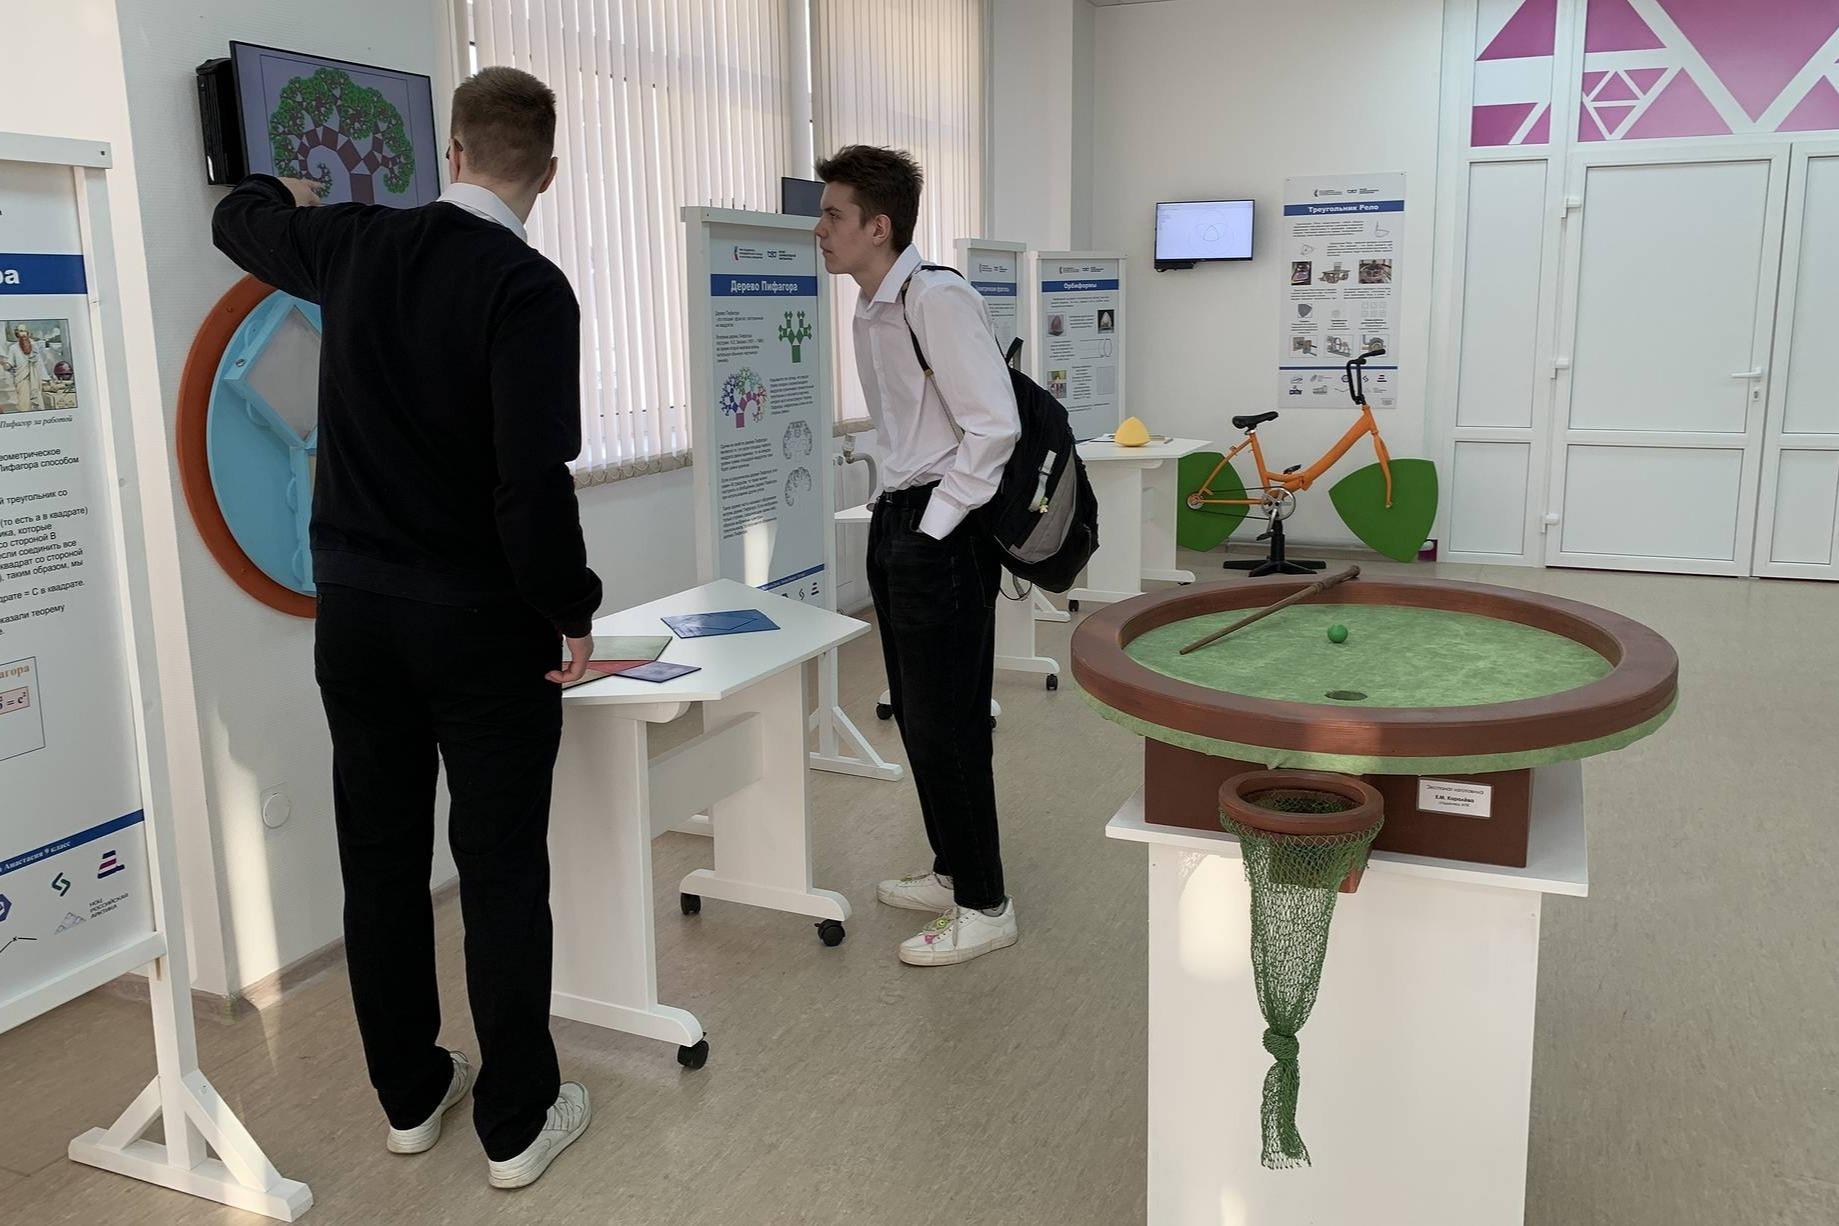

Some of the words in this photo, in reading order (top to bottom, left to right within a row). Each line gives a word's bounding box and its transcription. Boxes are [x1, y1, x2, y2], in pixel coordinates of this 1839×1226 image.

[730, 280, 760, 293] Дерево
[761, 280, 798, 294] Пифагора
[1063, 282, 1097, 290] Орбиформы
[41, 456, 80, 468] способом
[7, 492, 57, 504] треугольник
[58, 489, 68, 497] со
[1, 518, 13, 528] (то
[15, 516, 34, 525] есть
[50, 506, 88, 518] квадрате)
[18, 523, 52, 534] которые
[10, 533, 48, 547] стороной
[19, 543, 62, 556] соединить
[63, 540, 77, 549] все
[35, 556, 45, 564] со
[47, 548, 83, 561] стороной
[6, 569, 31, 580] таким
[33, 564, 69, 576] образом,
[41, 587, 46, 595] в
[31, 604, 65, 616] теорему
